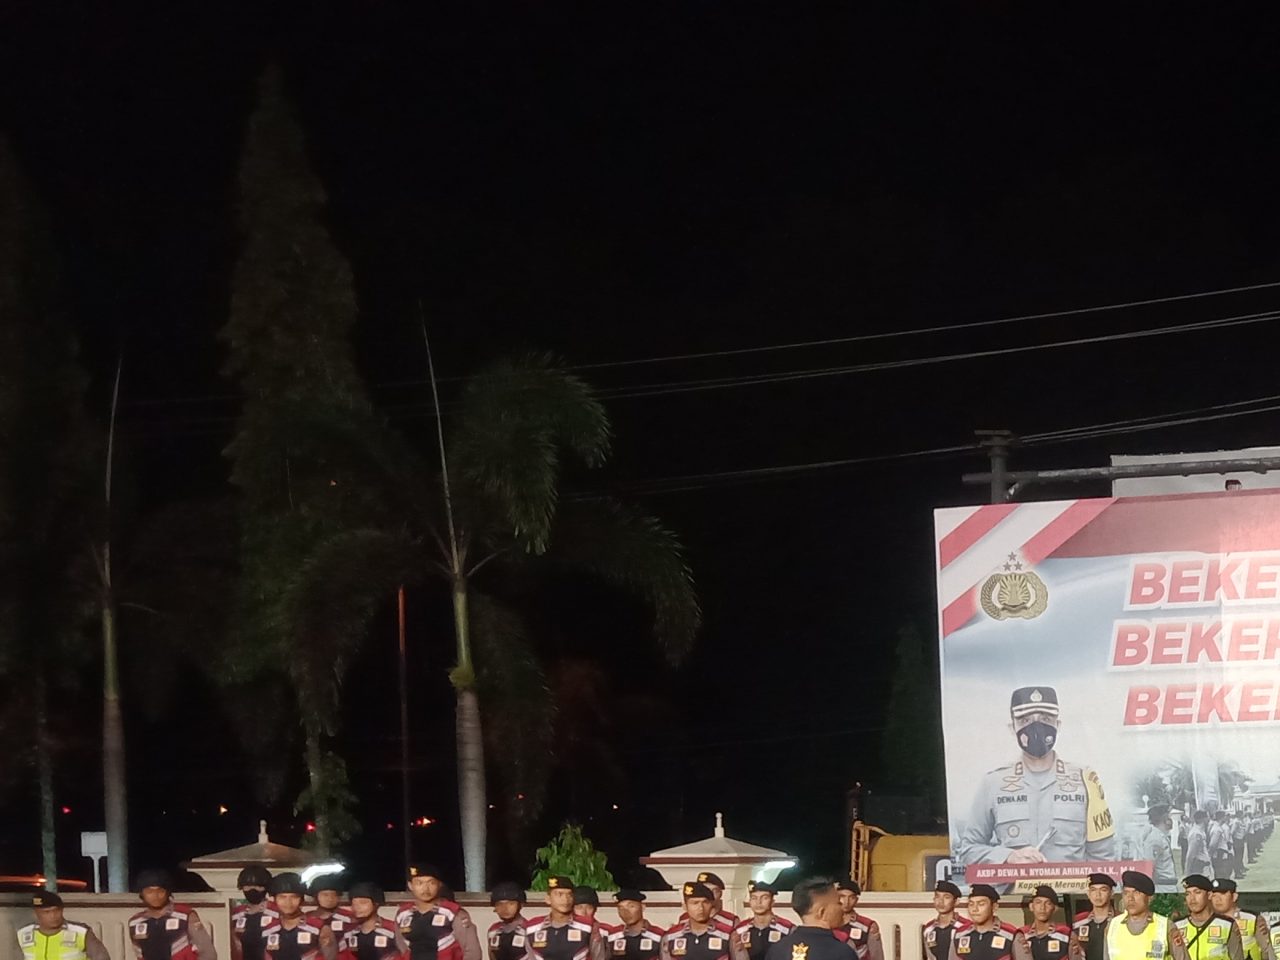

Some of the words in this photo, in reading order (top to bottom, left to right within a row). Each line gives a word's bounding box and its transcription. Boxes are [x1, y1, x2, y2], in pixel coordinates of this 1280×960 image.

[1054, 794, 1085, 802] POLRI
[976, 869, 995, 878] AKBP
[998, 868, 1018, 877] DEWA
[1020, 868, 1027, 876] N.
[1029, 867, 1060, 876] NYOMAN
[1055, 879, 1089, 889] Merangi
